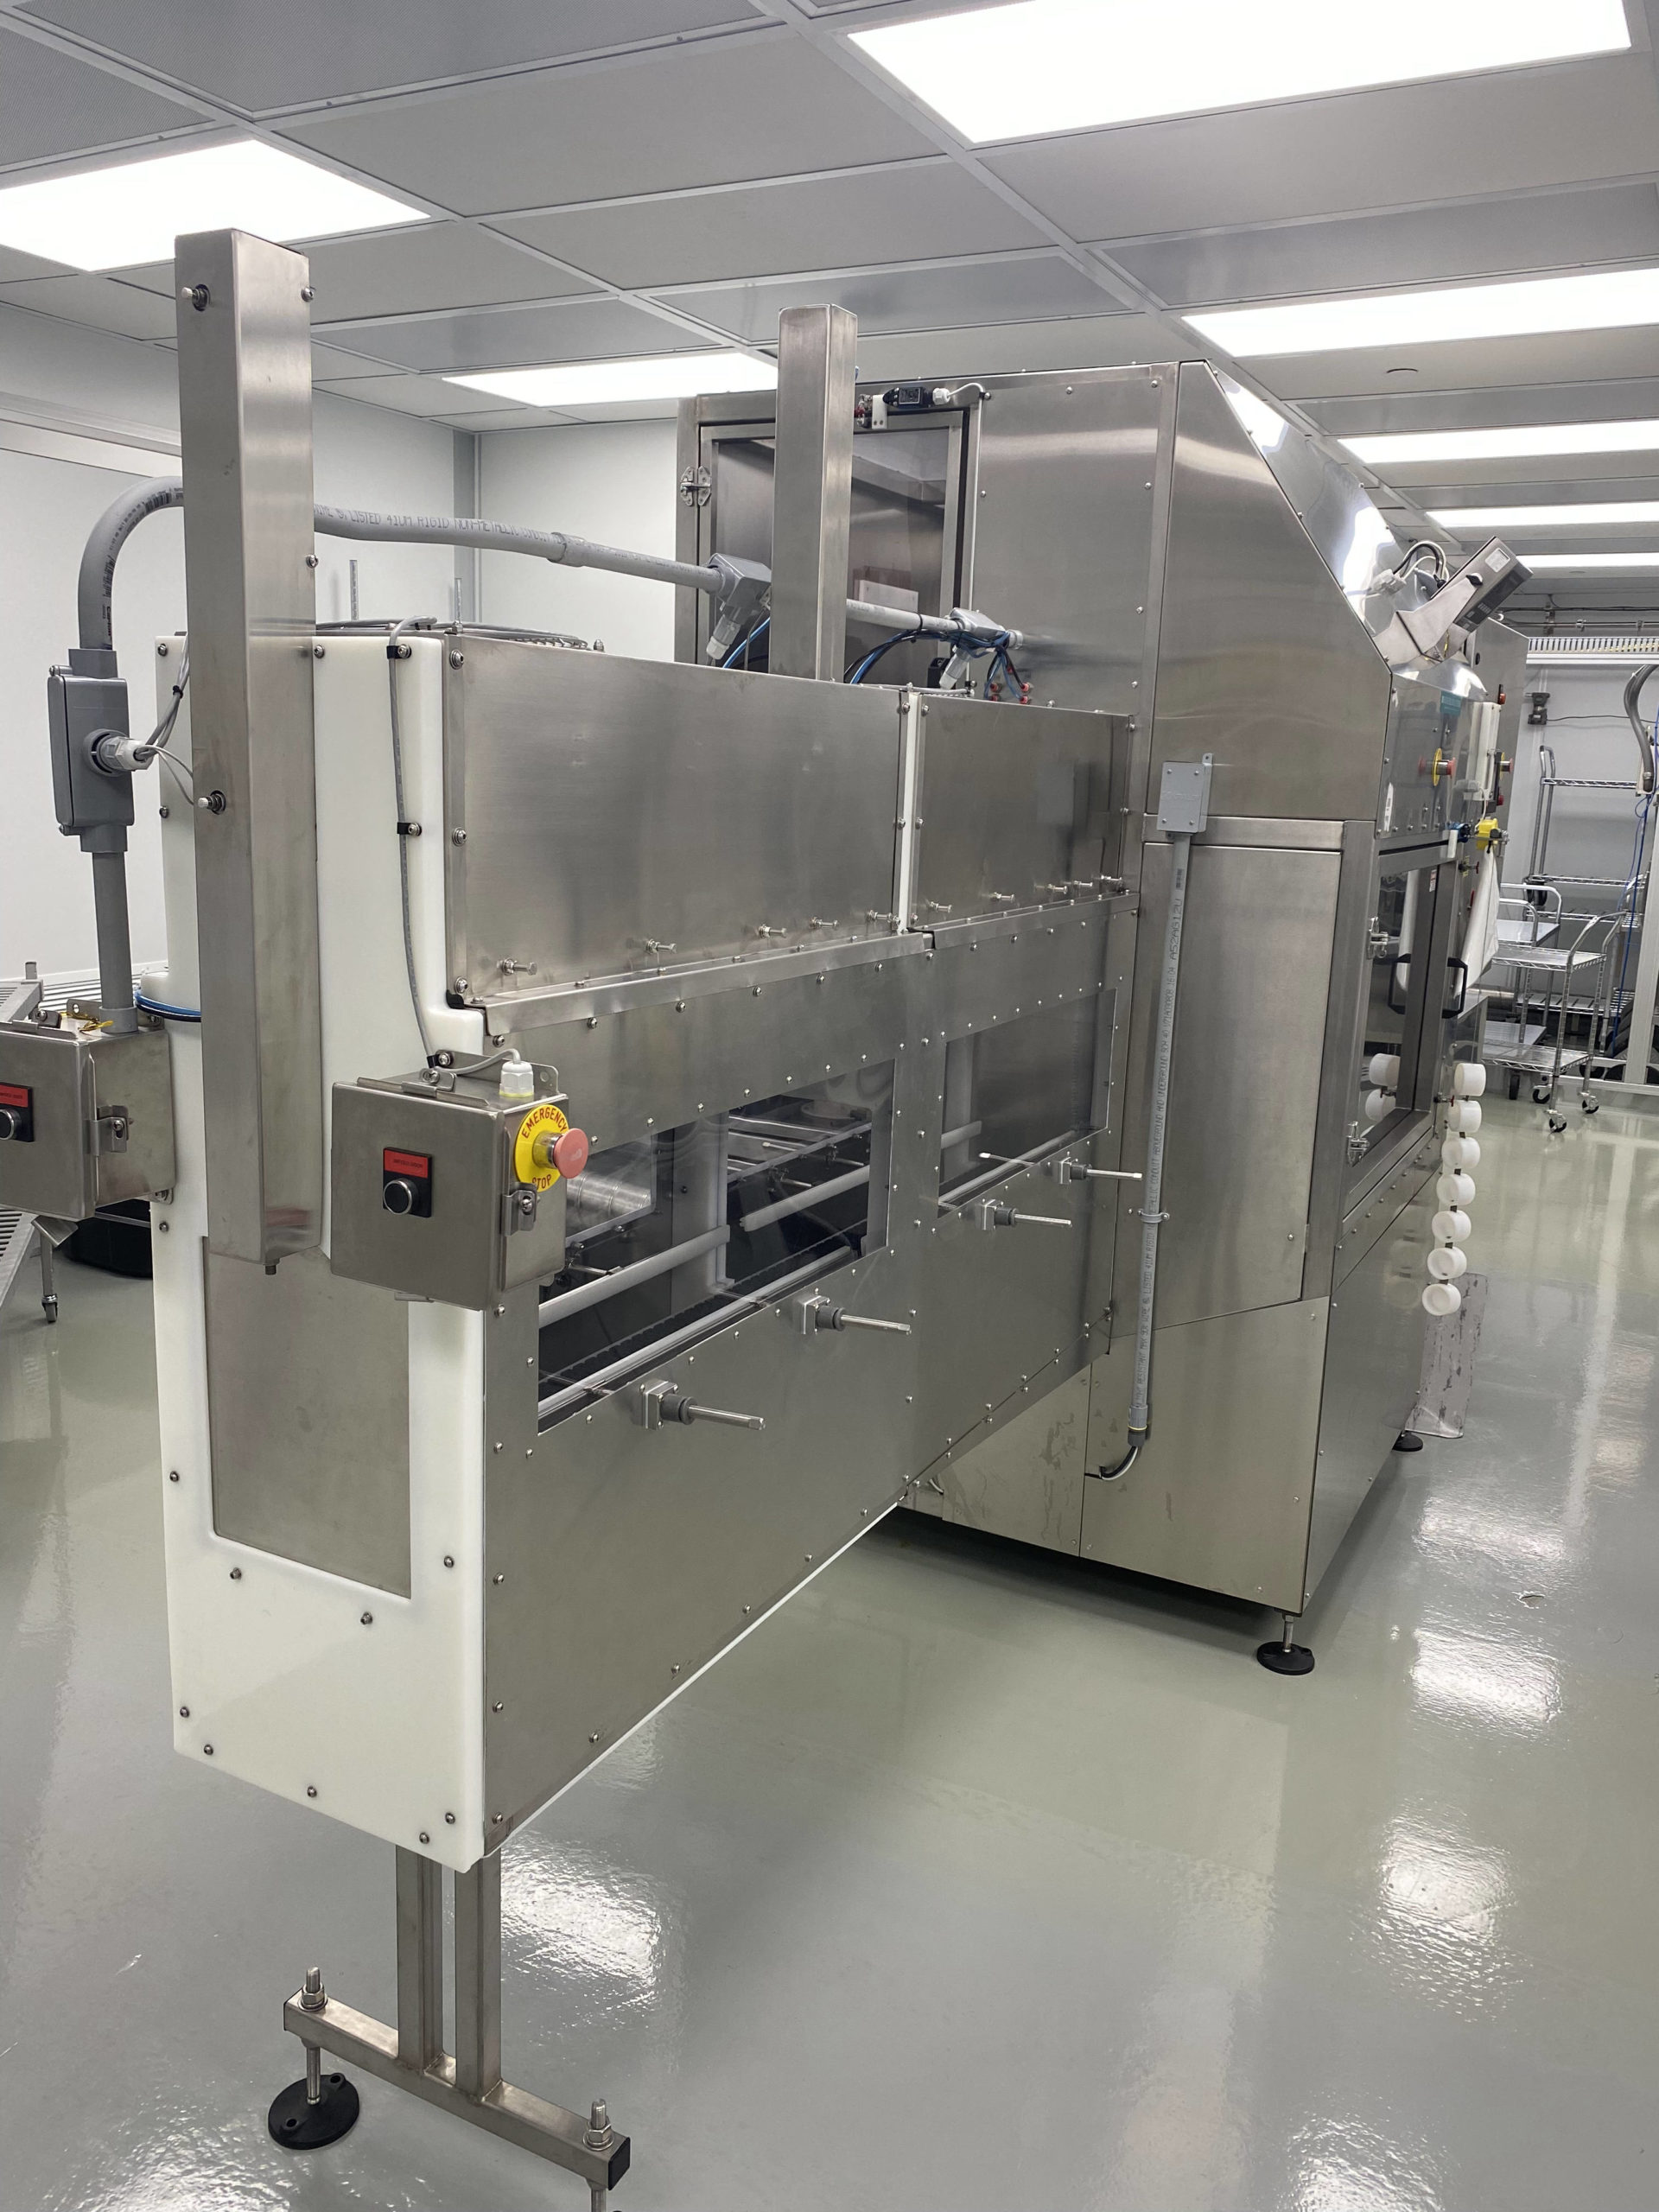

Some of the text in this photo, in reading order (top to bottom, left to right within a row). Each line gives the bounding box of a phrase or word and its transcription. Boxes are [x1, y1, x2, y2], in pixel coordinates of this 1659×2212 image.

[349, 510, 381, 525] LISTED
[417, 516, 450, 529] RIGID
[1156, 1055, 1168, 1097] UNDERGROUND
[1155, 1098, 1165, 1111] AND
[521, 1106, 568, 1139] EMERGENCY
[1152, 1113, 1163, 1155] ABOVEGROUND
[531, 1173, 552, 1189] STOP
[1150, 1157, 1160, 1184] CONDUIT
[1145, 1232, 1154, 1251] RIGID
[1142, 1271, 1152, 1294] LISTED
